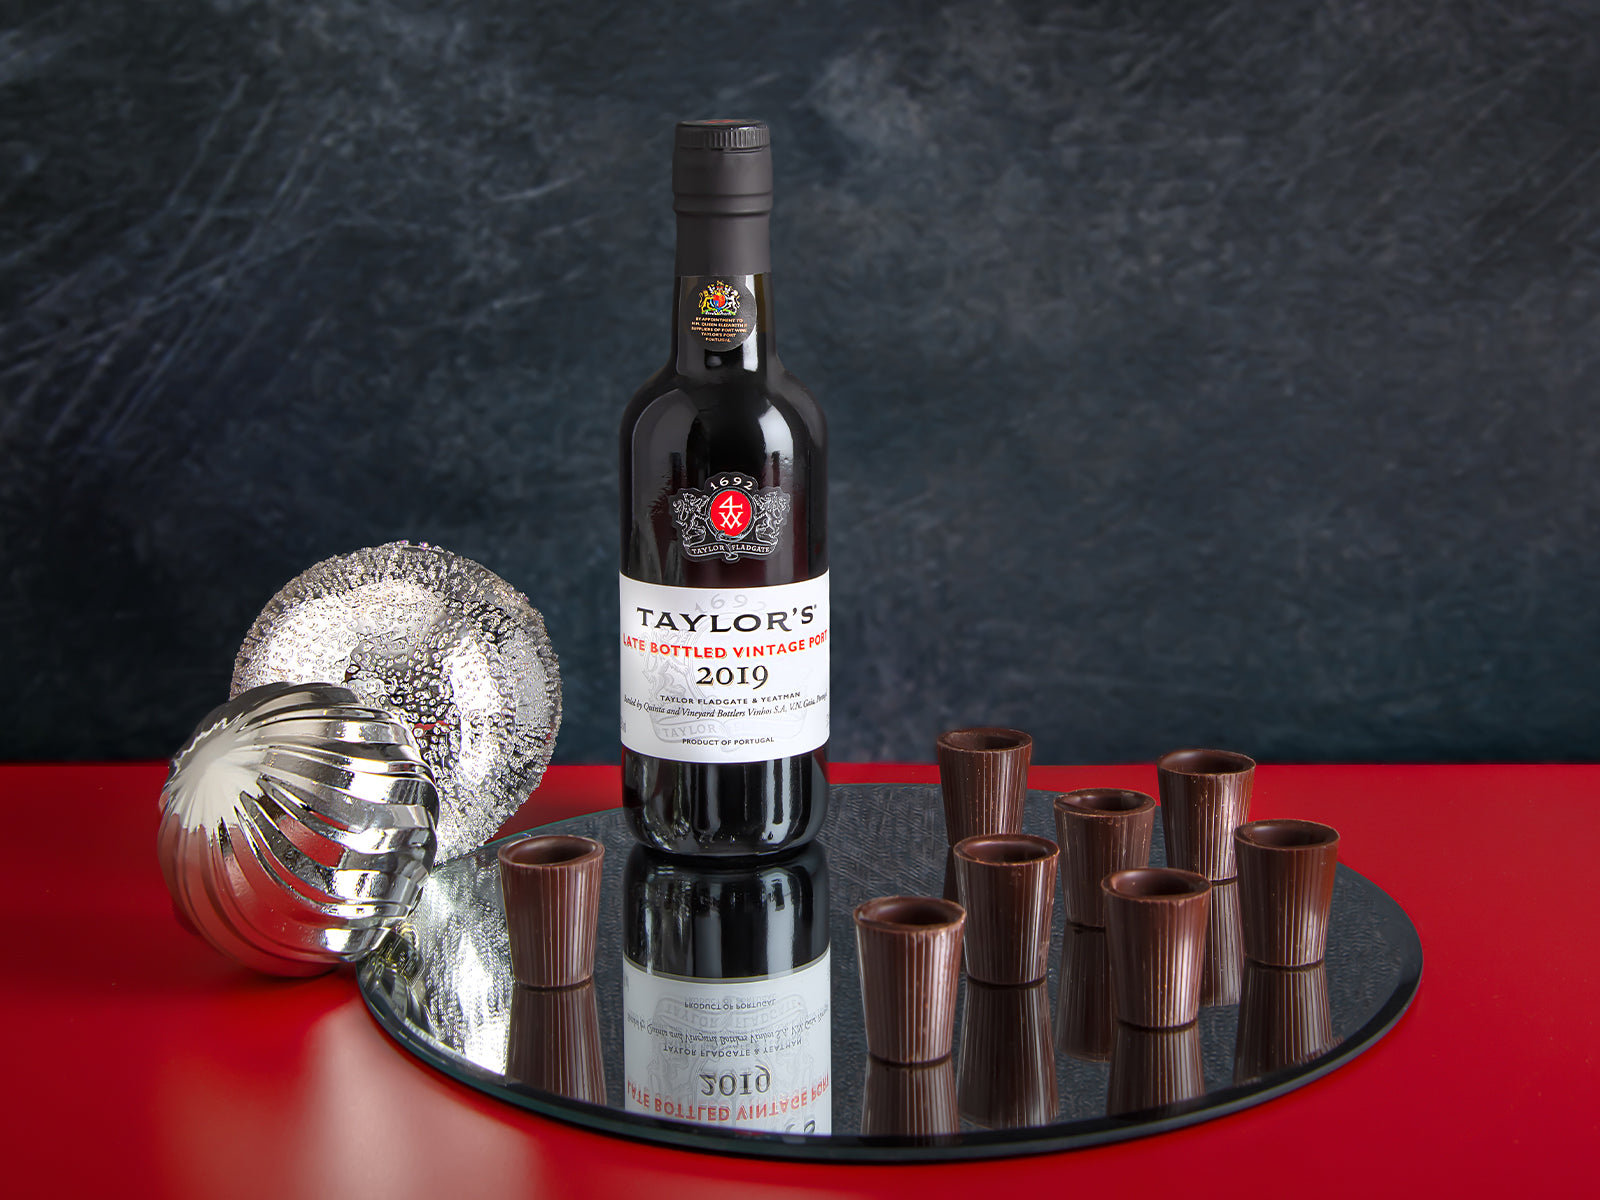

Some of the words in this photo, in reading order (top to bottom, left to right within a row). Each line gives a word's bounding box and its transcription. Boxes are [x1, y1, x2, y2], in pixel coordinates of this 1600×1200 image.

[710, 476, 753, 490] 1692
[691, 544, 725, 555] TAYLOR
[731, 544, 770, 553] FLADGATE
[637, 604, 814, 632] TAYLOR'S
[622, 632, 646, 652] LATE
[650, 641, 727, 659] BOTTLED
[733, 638, 805, 658] VINTAGE
[809, 629, 828, 648] PORT
[696, 665, 769, 690] 2019
[660, 694, 694, 705] TAYLOR
[697, 698, 748, 706] FLADGATE
[761, 691, 801, 702] YEATMAN
[643, 702, 665, 713] Quinta
[667, 707, 680, 715] and
[682, 707, 716, 719] Vineyard
[717, 709, 746, 718] Bottlers
[748, 707, 772, 717] Vinhos
[662, 724, 717, 738] TAYLOR
[682, 737, 719, 746] PRODUCT
[721, 738, 732, 746] OF
[734, 736, 774, 745] PORTUGAL
